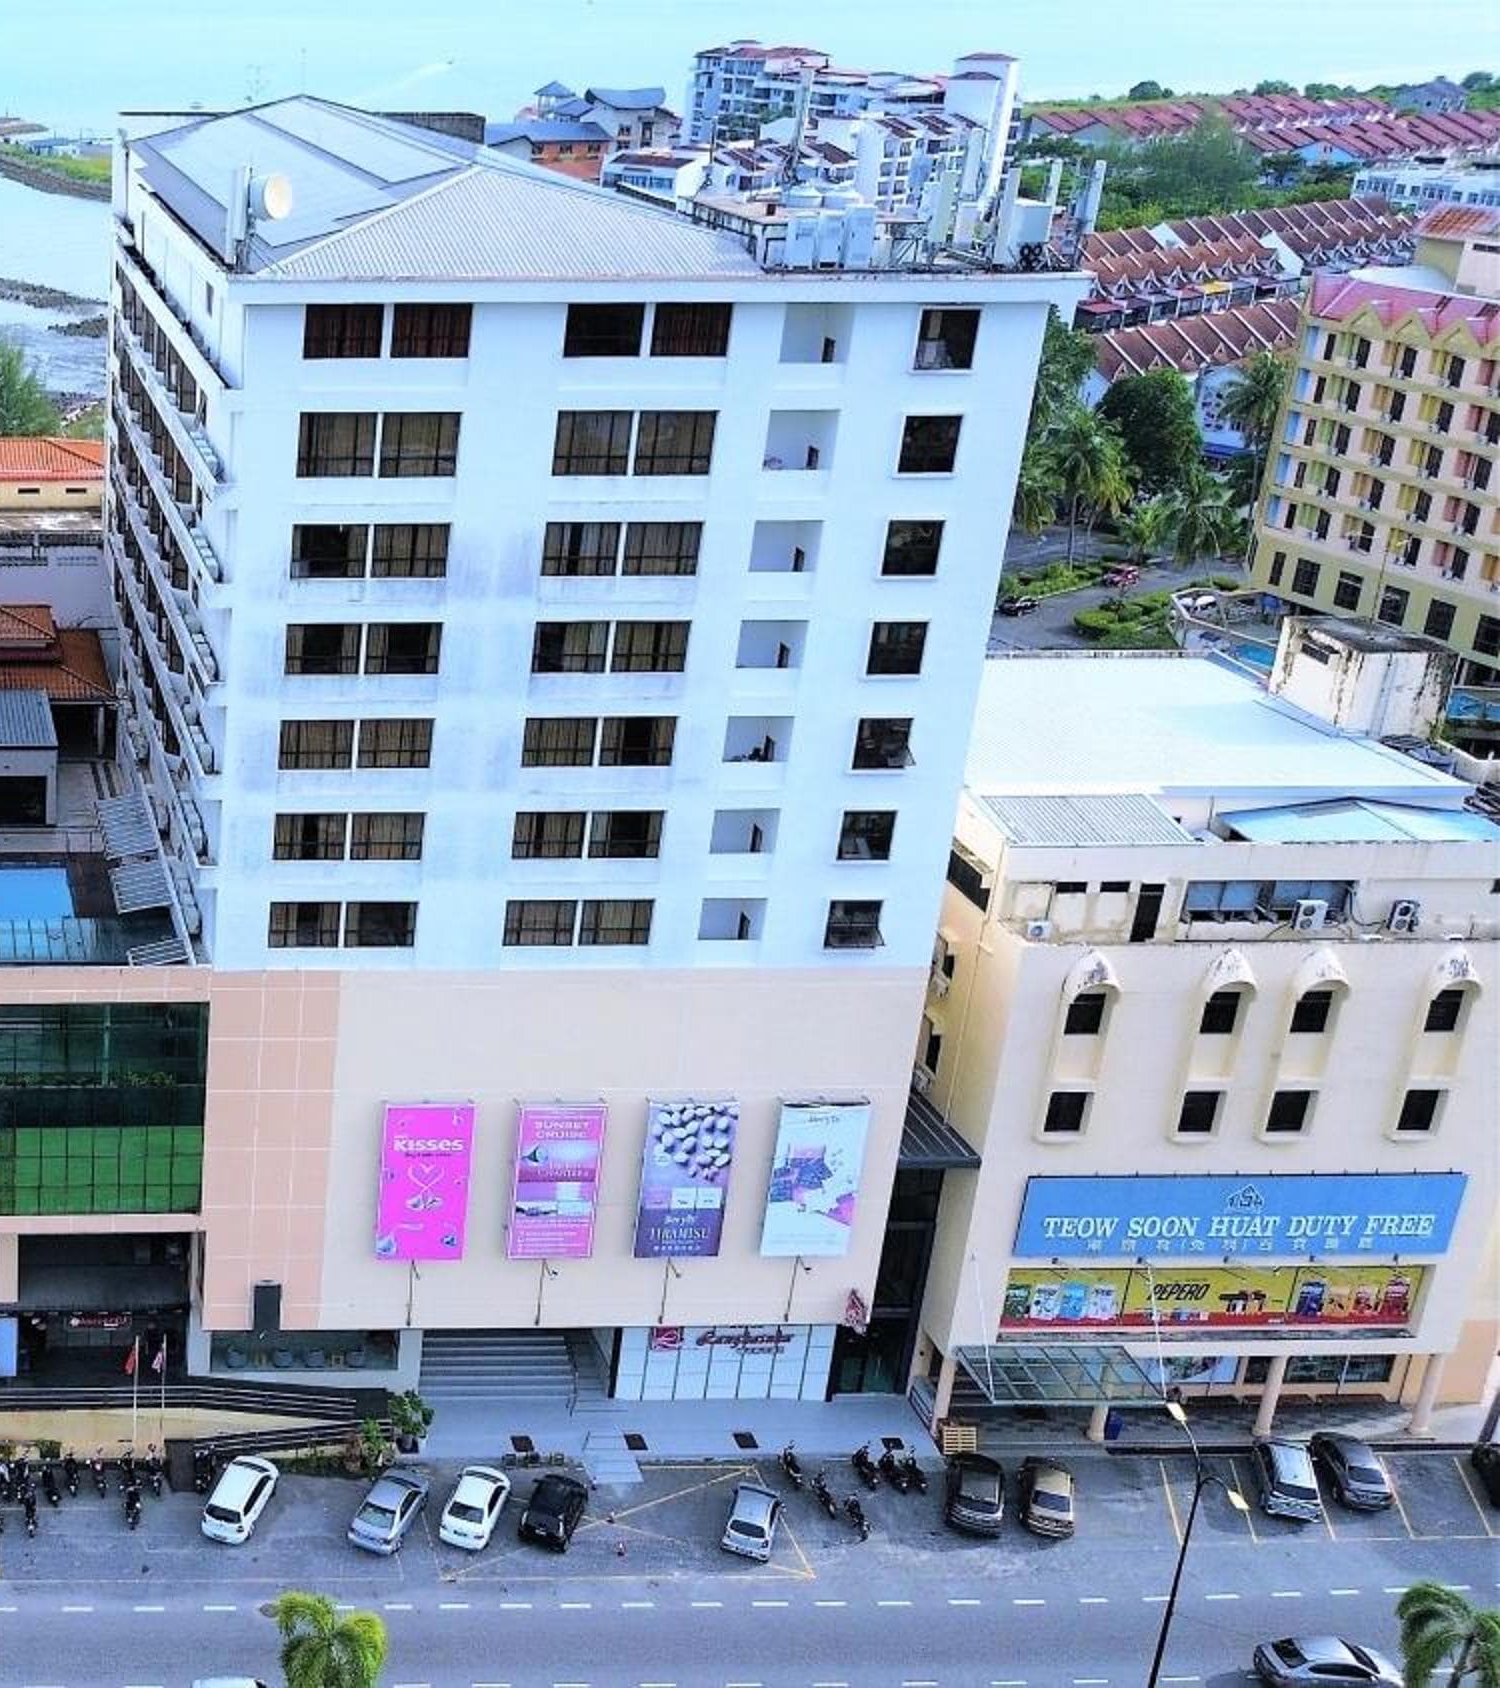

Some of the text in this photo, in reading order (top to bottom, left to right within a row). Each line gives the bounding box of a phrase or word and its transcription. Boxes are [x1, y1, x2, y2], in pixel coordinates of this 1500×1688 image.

[1044, 1214, 1435, 1238] TEOW SOON HUAT DUTY FREE
